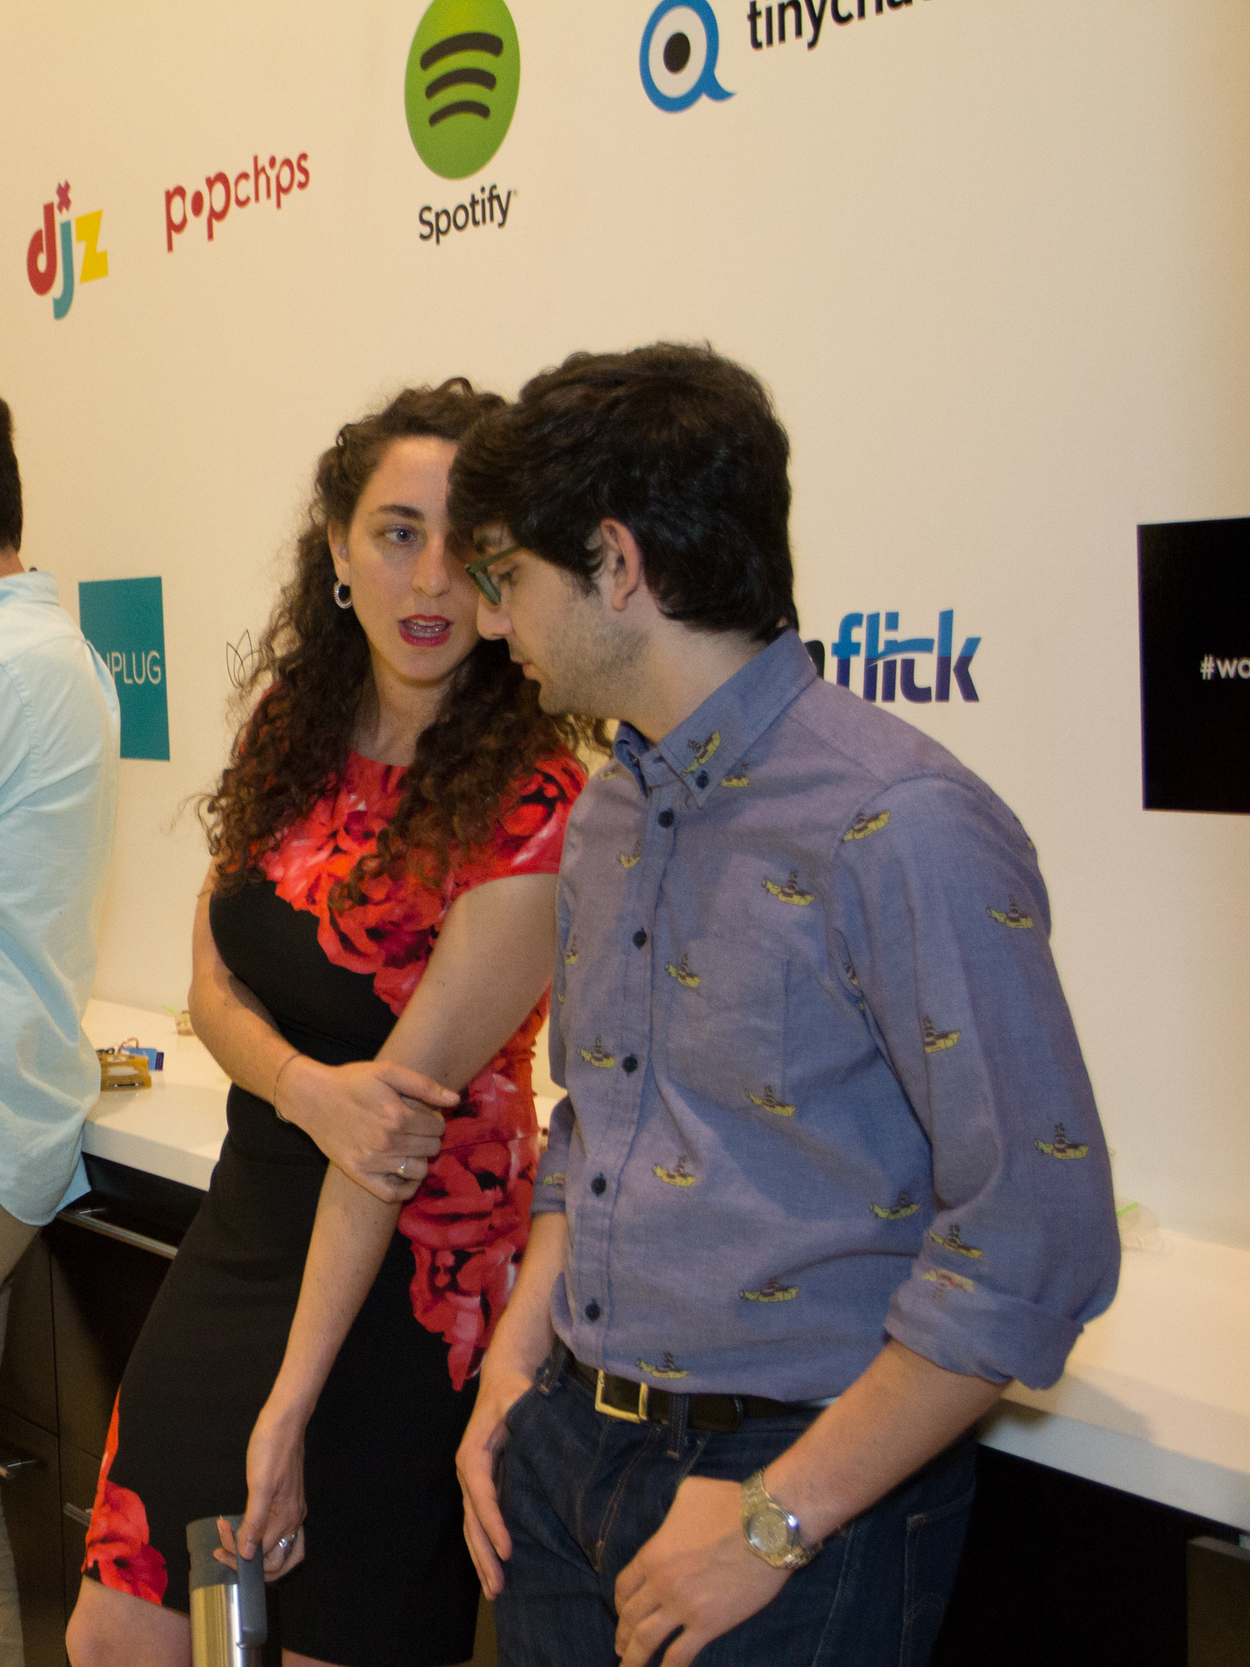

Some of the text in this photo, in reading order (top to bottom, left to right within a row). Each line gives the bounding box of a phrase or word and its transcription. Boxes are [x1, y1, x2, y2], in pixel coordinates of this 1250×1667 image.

[745, 0, 932, 51] tinyc
[164, 152, 310, 253] popchips
[418, 183, 512, 246] Spotify
[26, 179, 109, 320] djz
